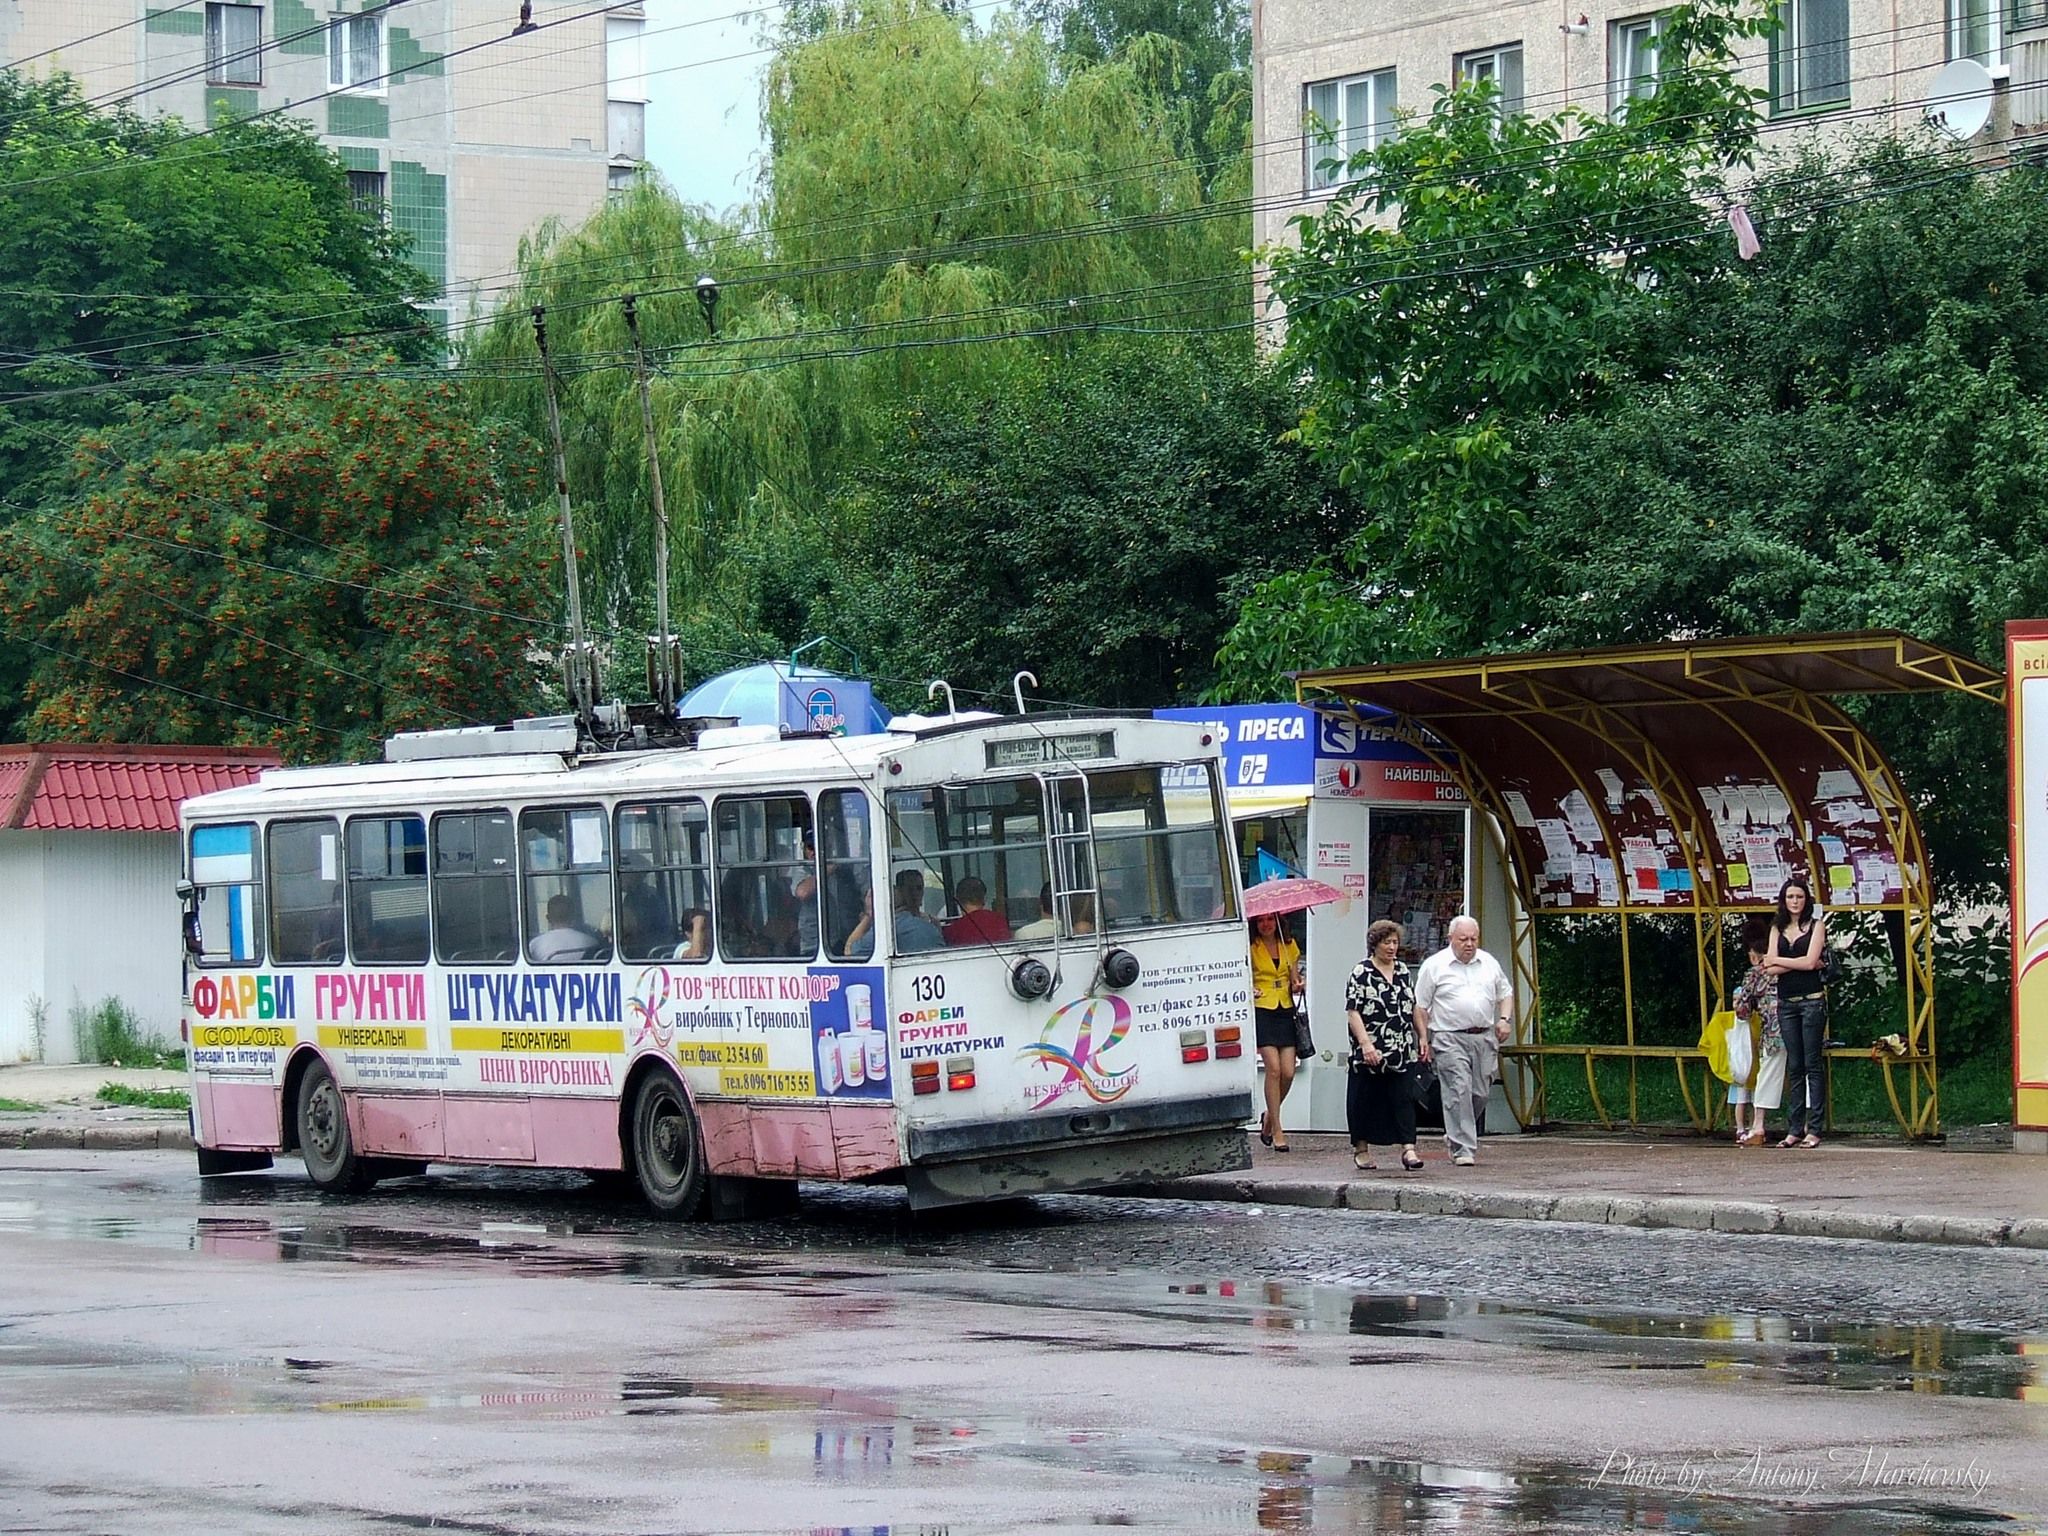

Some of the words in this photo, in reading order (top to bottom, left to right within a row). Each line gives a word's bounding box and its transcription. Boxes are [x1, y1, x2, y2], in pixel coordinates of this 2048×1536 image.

[1238, 716, 1305, 742] ПРЕСА
[1042, 738, 1057, 761] 11
[1238, 754, 1268, 784] 02
[1385, 765, 1459, 783] НАЙБІЛЬШ
[1142, 969, 1159, 978] ТОВ
[1142, 977, 1186, 989] виробник
[1197, 969, 1242, 982] Тернополі
[193, 975, 296, 1019] ФАРБИ
[314, 974, 426, 1021] ГРУНТИ
[447, 973, 623, 1022] ШТУКАТУРКИ
[674, 976, 701, 1000] ТОВ
[911, 975, 945, 1001] 130
[1136, 999, 1193, 1014] тел/факс
[1196, 994, 1210, 1007] 23
[1214, 992, 1228, 1005] 54
[1233, 990, 1246, 1003] 60
[675, 1005, 733, 1032] виробник
[736, 1011, 743, 1032] у
[744, 1005, 809, 1033] Тернополі
[899, 1006, 965, 1024] ФАРБИ
[1138, 1022, 1160, 1033] тел.
[1195, 1013, 1215, 1025] 716
[1218, 1011, 1231, 1023] 75
[1234, 1009, 1248, 1021] 55
[203, 1026, 286, 1046] COLOR
[337, 1028, 407, 1047] УНІВЕРСАЛЬНІ
[501, 1031, 571, 1051] ДЕКОРАТИВНІ
[899, 1023, 968, 1043] ГРУНТИ
[194, 1047, 224, 1064] фасадні
[226, 1051, 235, 1063] та
[680, 1045, 722, 1068] тел/факс
[726, 1045, 738, 1064] 23
[739, 1046, 750, 1064] 54
[752, 1047, 763, 1064] 60
[900, 1036, 1005, 1060] ШТУКАТУРКИ
[479, 1057, 515, 1083] ЦІНИ
[520, 1058, 613, 1086] ВИРОБНИКА
[767, 1075, 784, 1092] 716
[785, 1075, 797, 1092] 75
[798, 1075, 809, 1092] 55
[1024, 1080, 1084, 1098] RESPECT
[1092, 1075, 1139, 1089] COLOR
